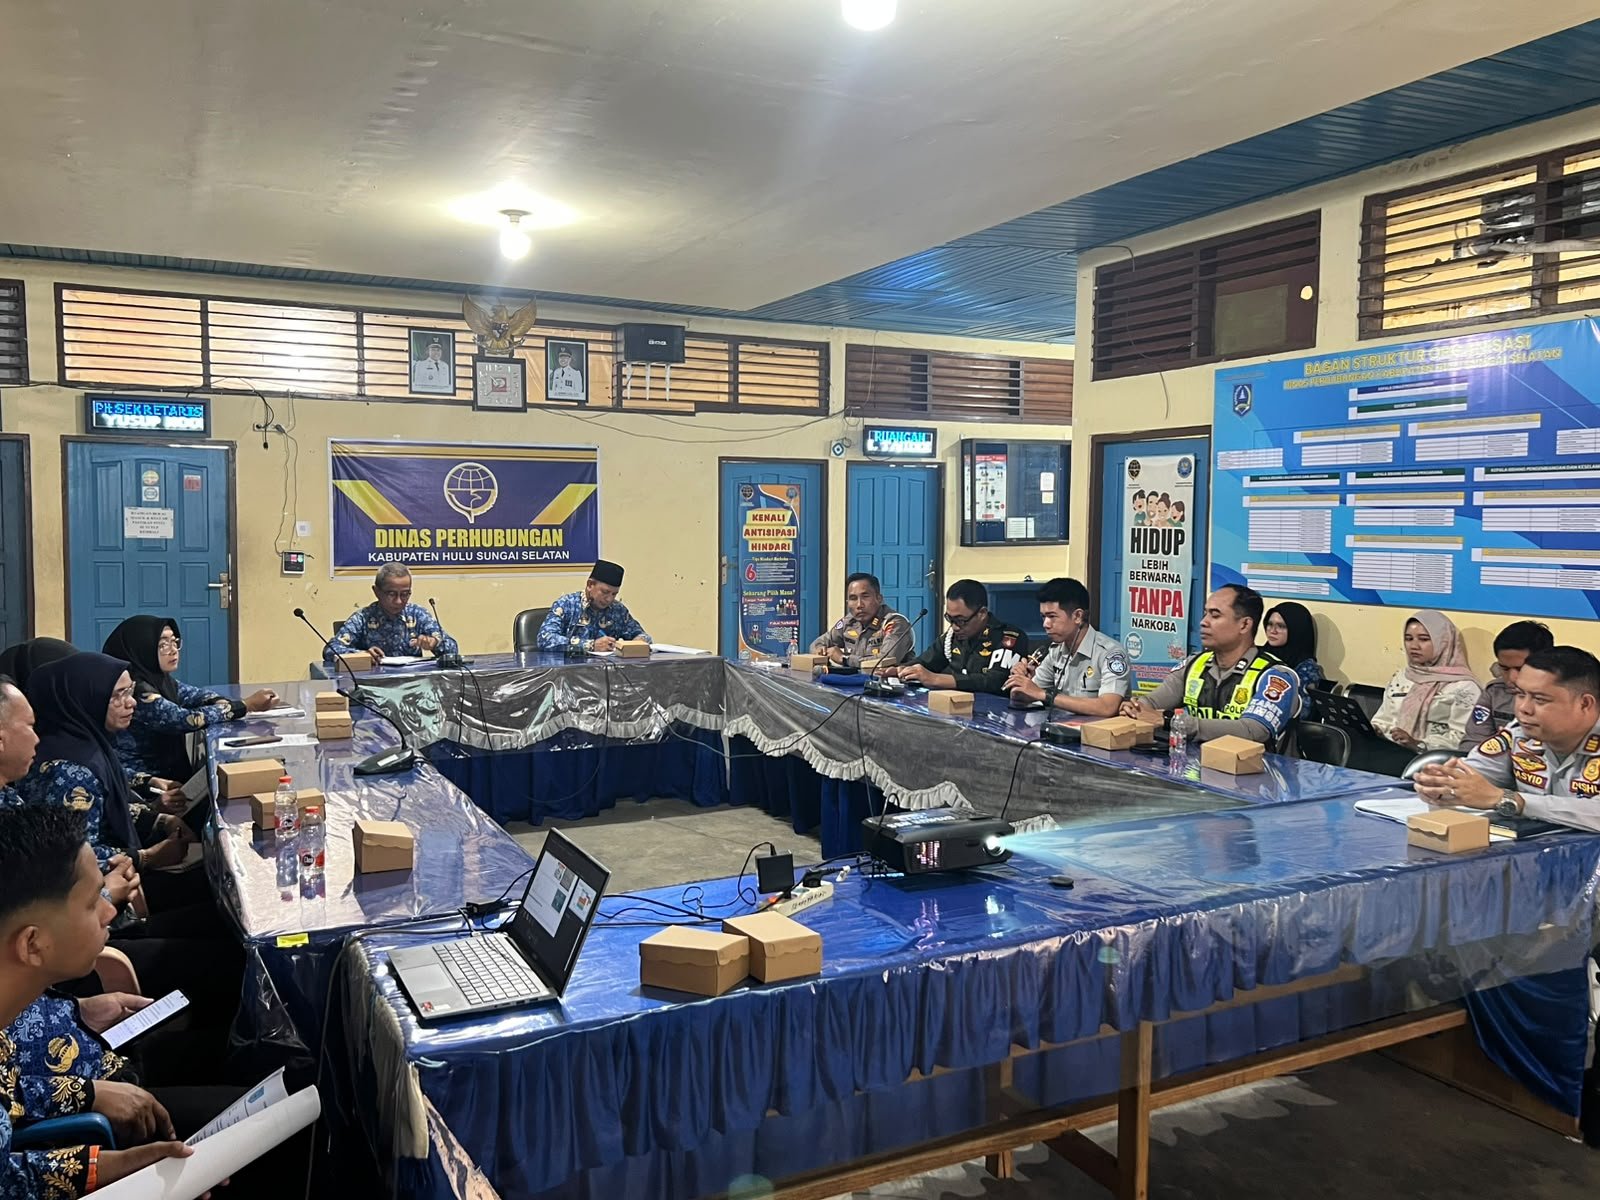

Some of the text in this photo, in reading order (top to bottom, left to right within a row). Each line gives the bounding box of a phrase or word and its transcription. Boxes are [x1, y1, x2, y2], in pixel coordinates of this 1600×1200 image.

[1304, 357, 1351, 377] BAGAN
[1353, 349, 1425, 371] STRUKTUR
[752, 513, 785, 522] KENALI
[375, 528, 563, 548] DINAS PERHUBUNGAN
[744, 528, 795, 537] ANTISIPASI
[751, 543, 790, 551] HINDARI
[1130, 527, 1185, 556] HIDUP
[368, 550, 570, 562] KABUPATEN HULU SUNGAI SELATAN
[745, 563, 757, 581] 6
[1141, 559, 1169, 571] LEBIH
[1129, 570, 1182, 585] BERWARNA
[1128, 586, 1184, 618] TANPA
[1132, 617, 1177, 633] NARKOBA
[988, 648, 1020, 670] PM
[1225, 704, 1245, 714] POLR
[1514, 770, 1543, 785] ASYID
